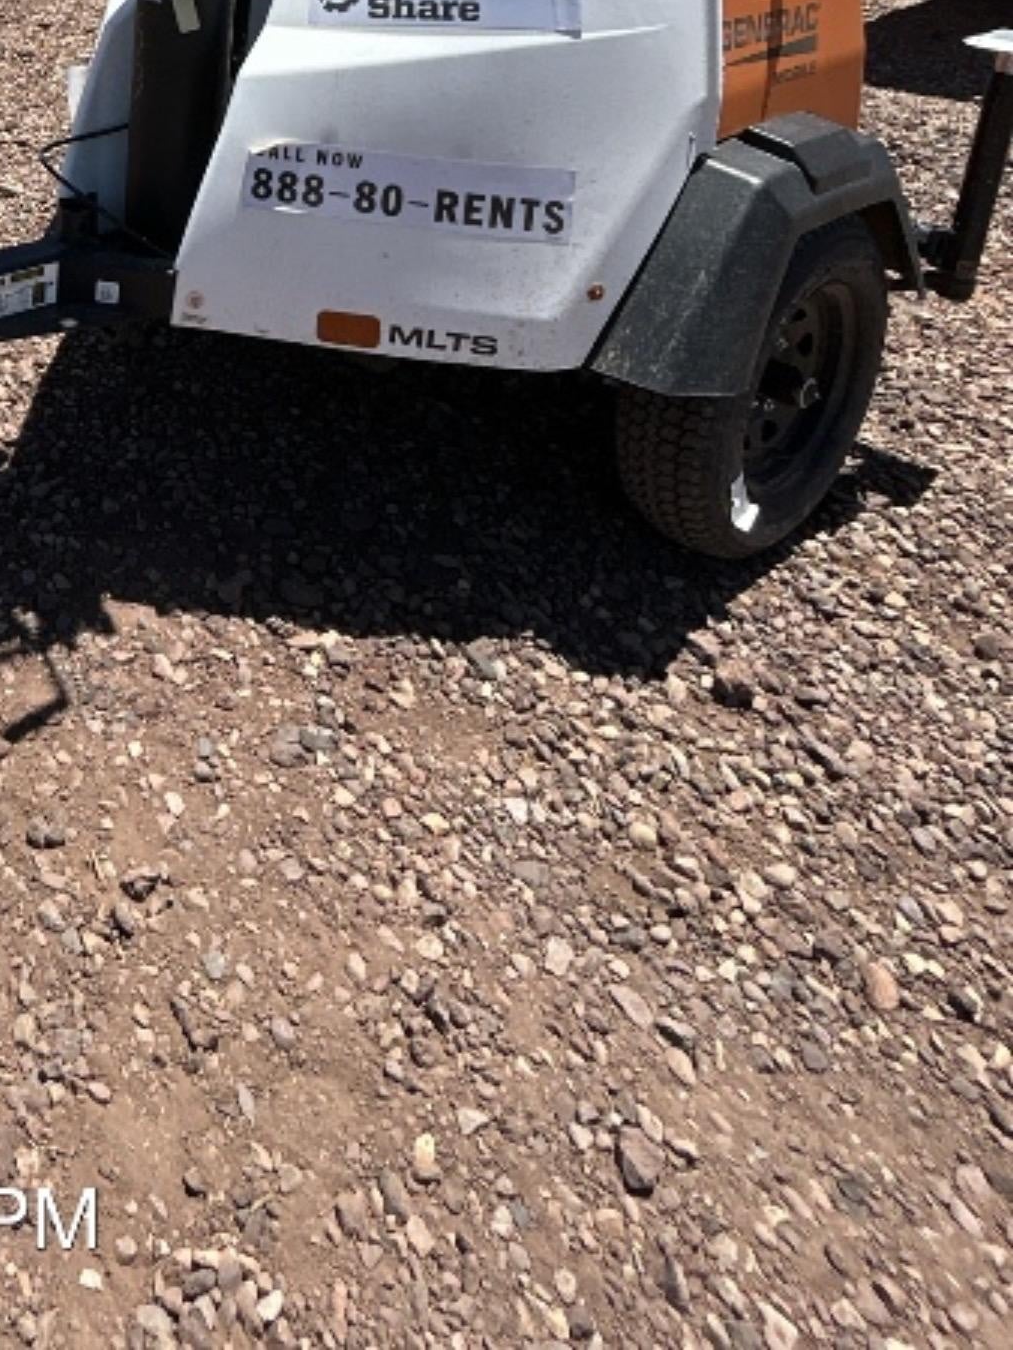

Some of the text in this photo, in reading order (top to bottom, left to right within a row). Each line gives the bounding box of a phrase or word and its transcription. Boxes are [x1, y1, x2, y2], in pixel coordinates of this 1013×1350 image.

[256, 146, 363, 168] ALL NOW
[250, 167, 565, 235] 888-80-RENTS
[388, 324, 499, 356] MLTS
